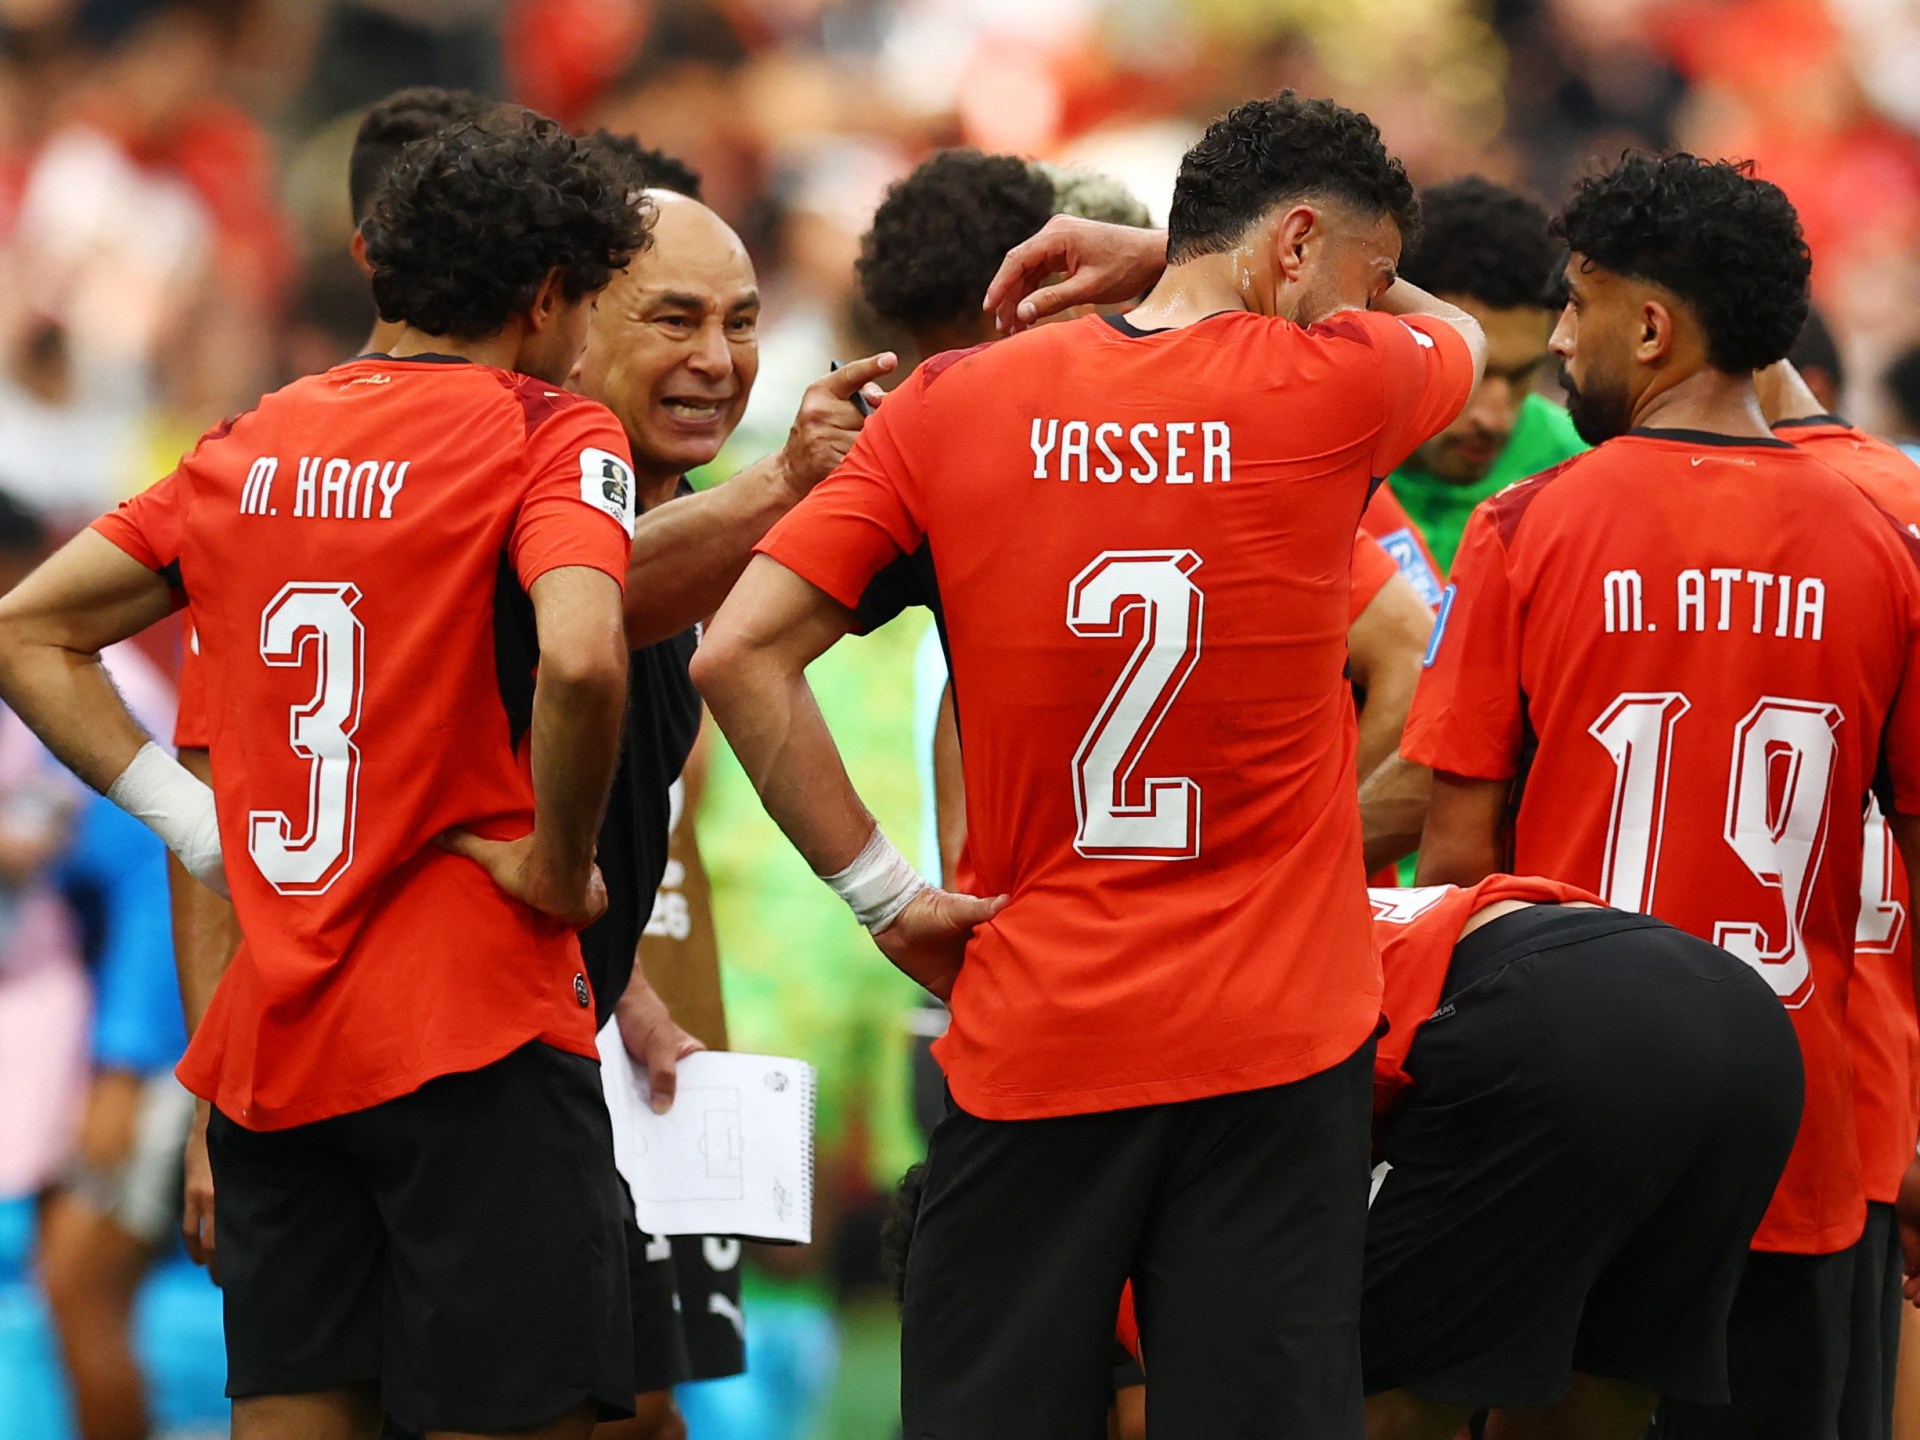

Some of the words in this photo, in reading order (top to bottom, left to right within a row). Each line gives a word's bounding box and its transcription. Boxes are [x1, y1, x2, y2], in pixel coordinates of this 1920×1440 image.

[239, 456, 278, 516] M.
[293, 456, 411, 519] HANY
[1030, 417, 1231, 484] YASSER
[1603, 569, 1656, 633] M.
[1677, 568, 1825, 641] ATTIA
[248, 581, 365, 896] 3
[1065, 548, 1204, 861] 2
[1587, 691, 1845, 1009] 19
